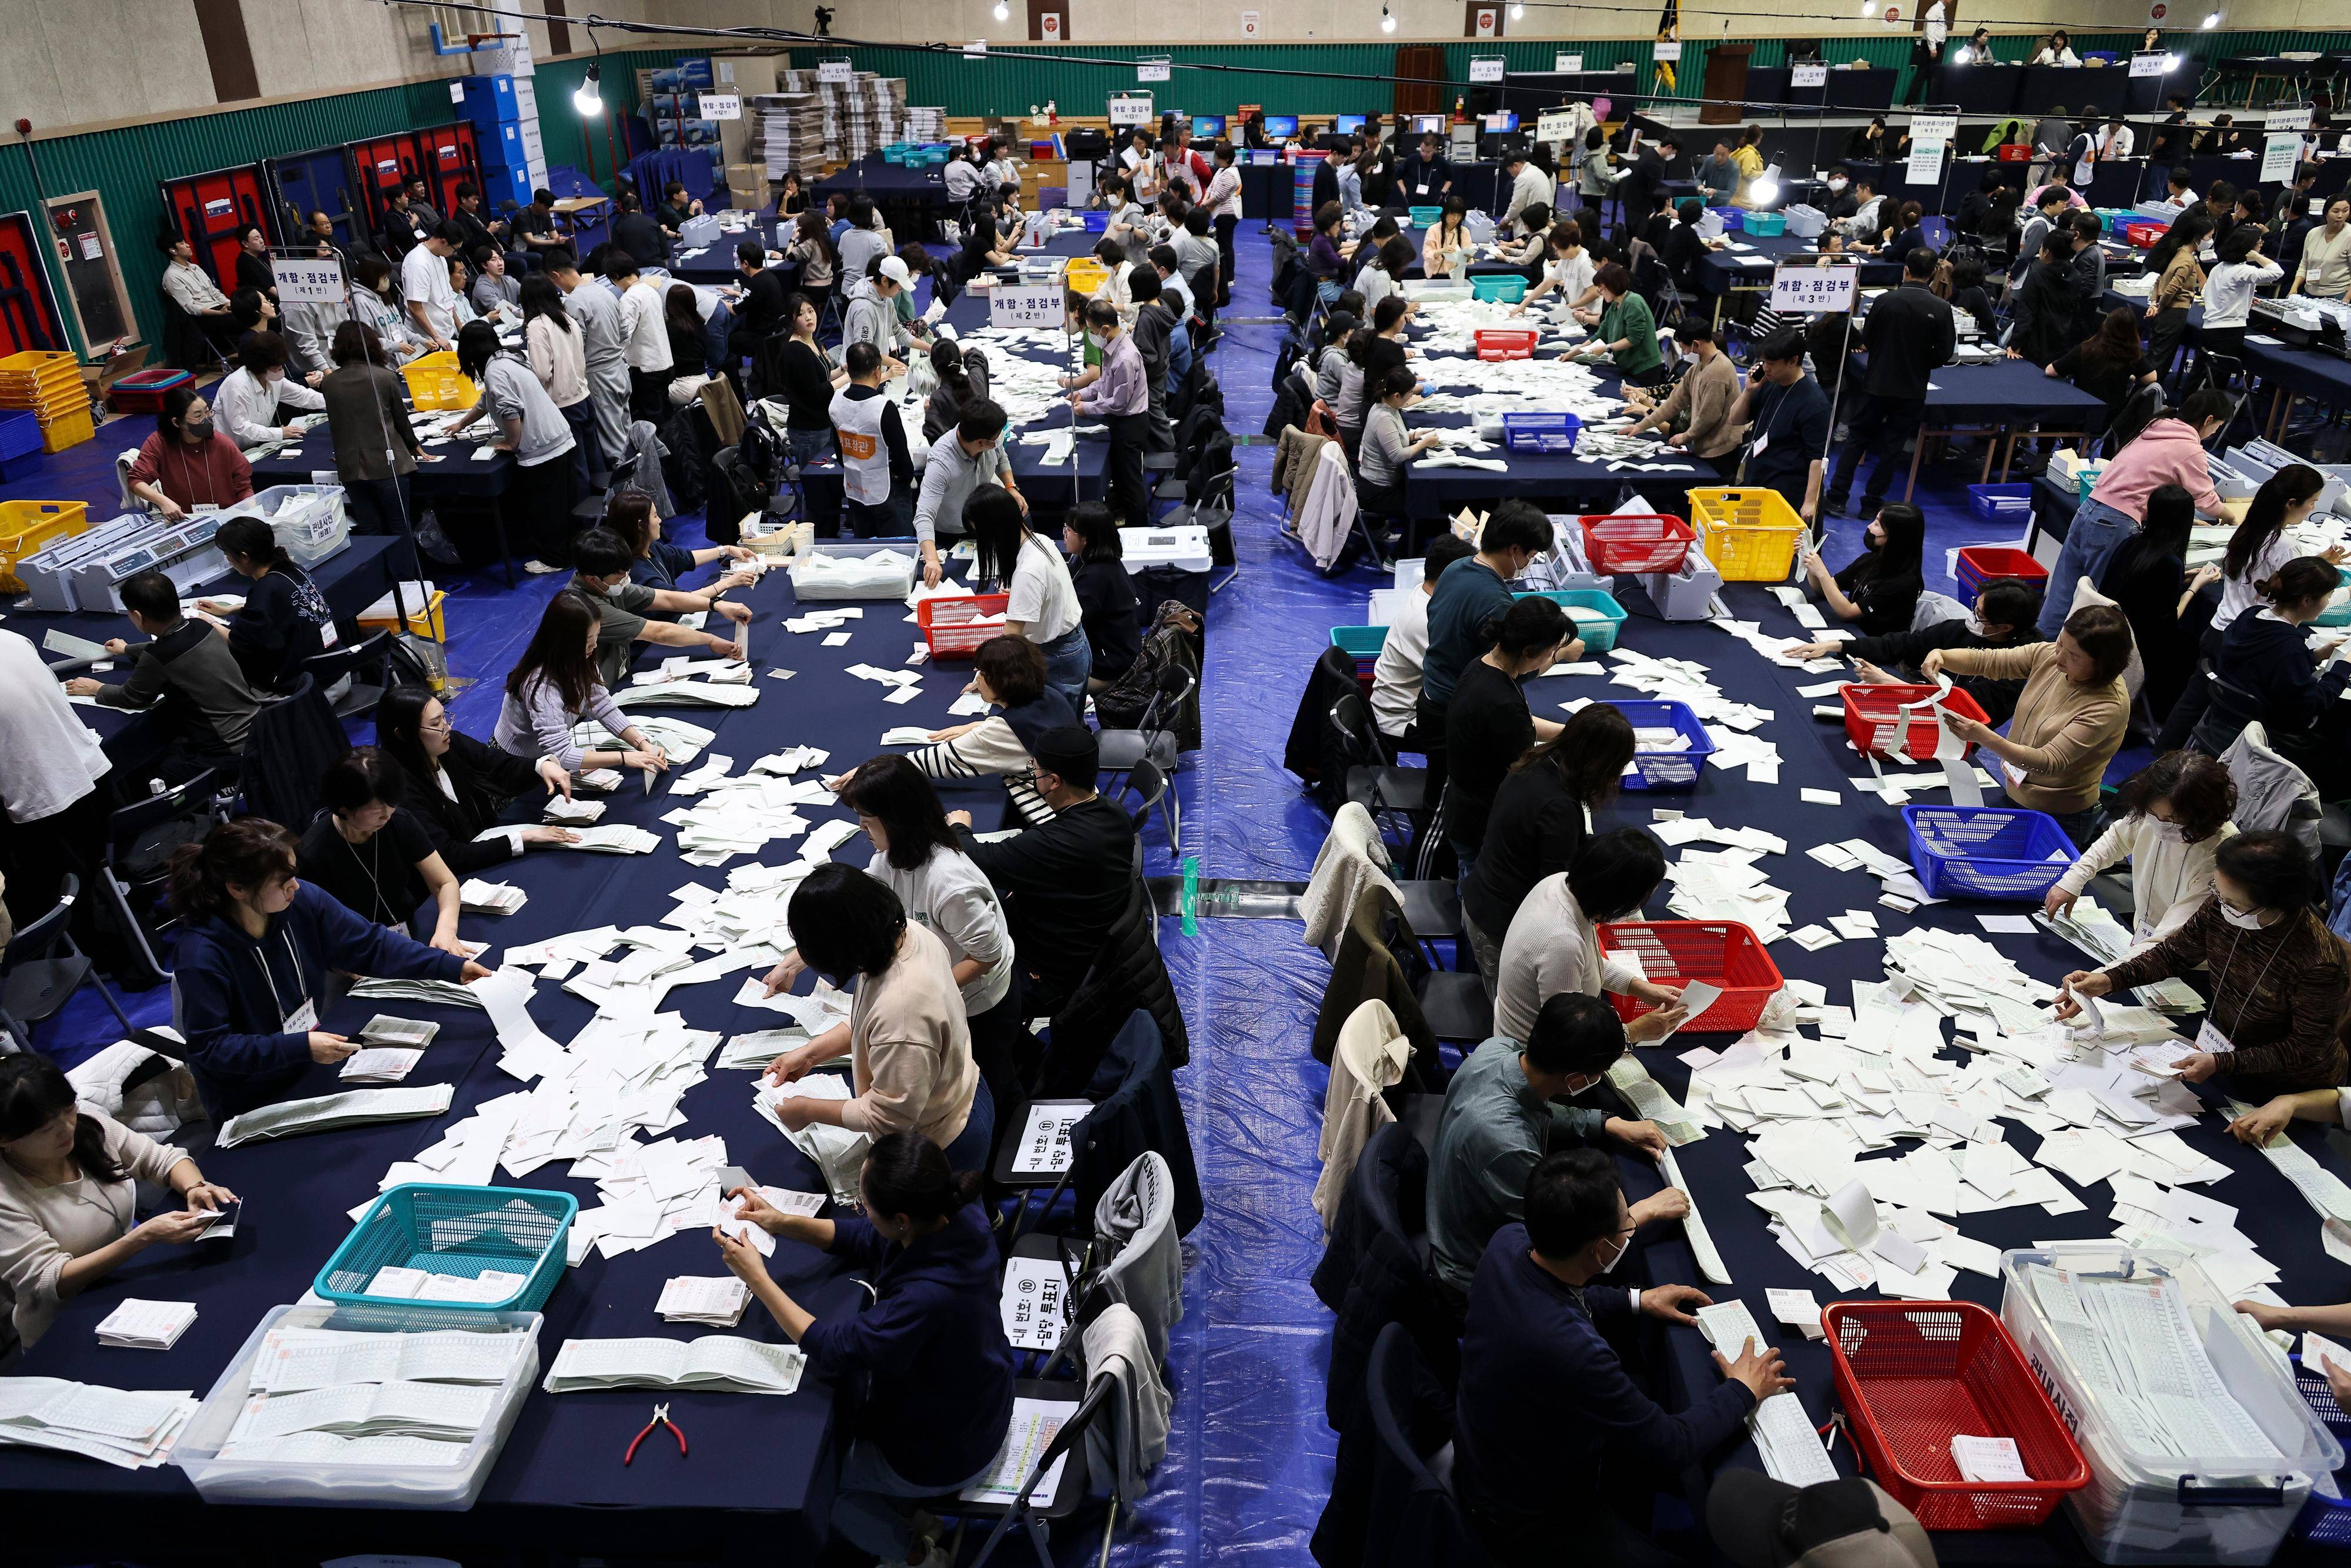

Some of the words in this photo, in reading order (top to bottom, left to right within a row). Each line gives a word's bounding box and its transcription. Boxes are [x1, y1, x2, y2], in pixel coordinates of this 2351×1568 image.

[278, 272, 339, 284] 개함·점검부
[295, 286, 327, 296] (제1반)
[1778, 280, 1850, 292] 개함·점검부
[994, 297, 1061, 310] 개함·점검부
[1793, 295, 1831, 304] (제3반)
[1010, 311, 1046, 320] (제2반)
[312, 514, 333, 532] 관내사전
[318, 527, 331, 539] (비례)
[288, 1007, 310, 1030] 개표사무원
[1034, 1135, 1048, 1153] 번호:
[1040, 1278, 1060, 1314] 투표지
[1016, 1299, 1031, 1322] 번호:
